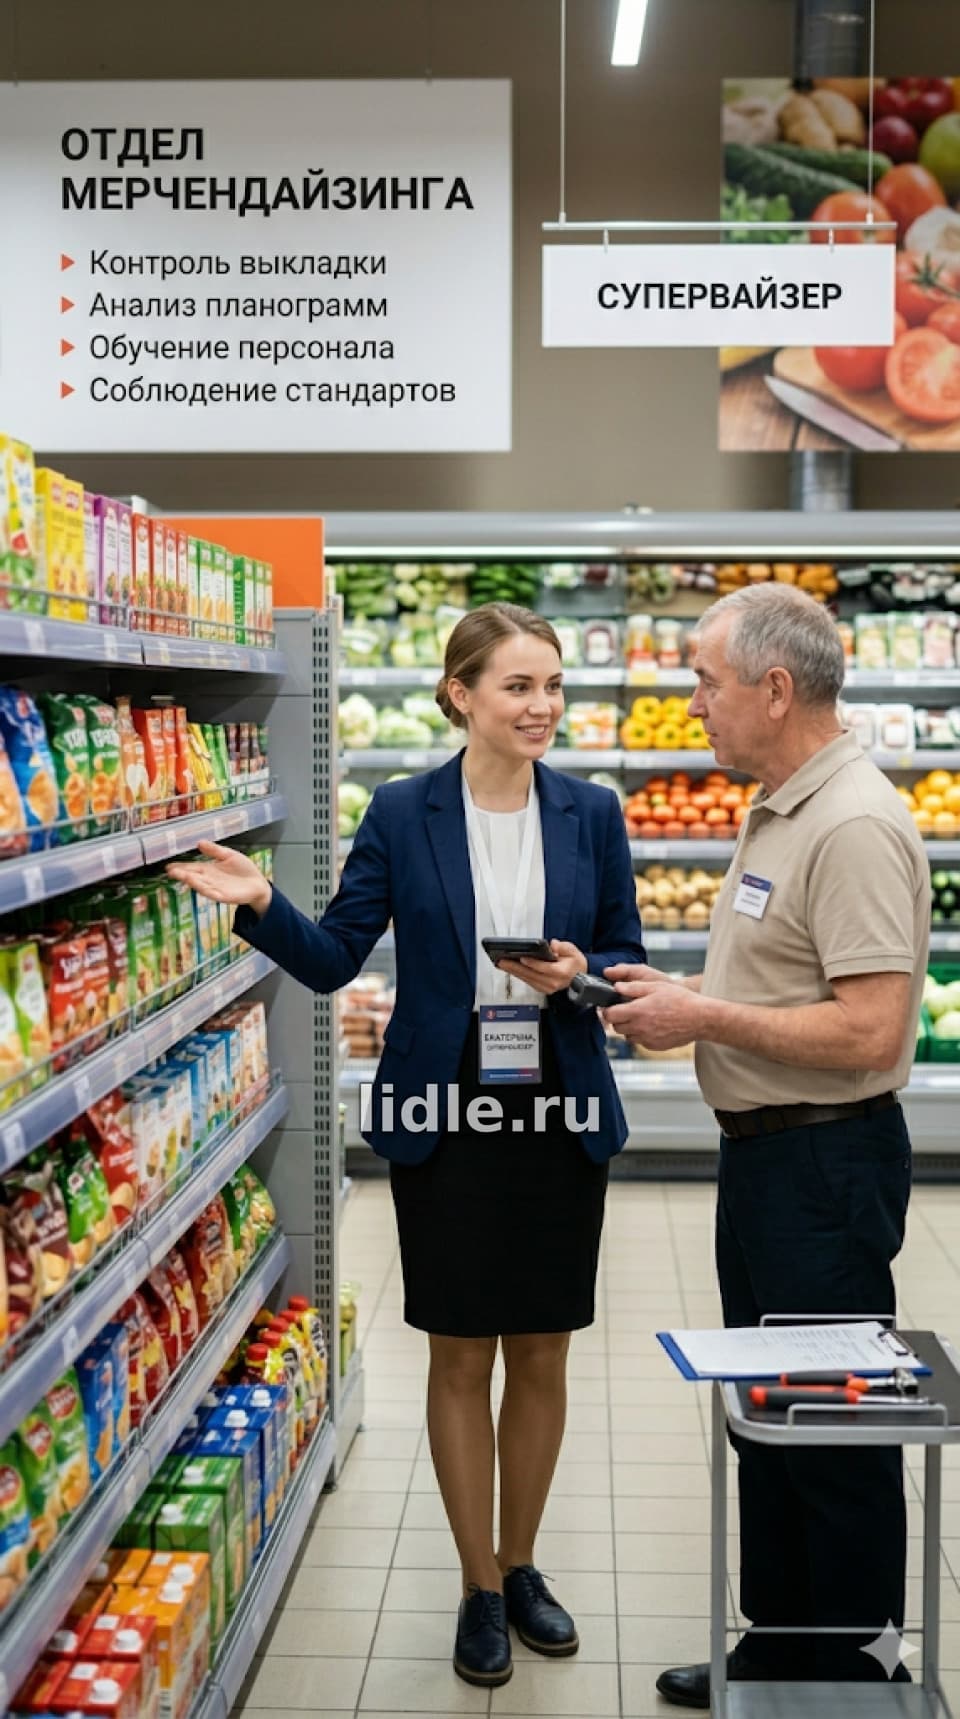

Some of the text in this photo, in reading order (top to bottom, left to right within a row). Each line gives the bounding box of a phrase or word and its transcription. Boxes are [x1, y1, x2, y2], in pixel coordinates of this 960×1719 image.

[60, 126, 206, 167] ОТДЕЛ
[61, 174, 475, 218] МЕРЧЕНДАЙЗИНГА
[89, 249, 388, 281] Контроль выкладки
[89, 291, 388, 324] Анализ планограмм
[597, 276, 843, 310] СУПЕРВАЙЗЕР
[89, 334, 395, 366] Обучение персонала
[89, 376, 457, 409] Соблюдение стандартов
